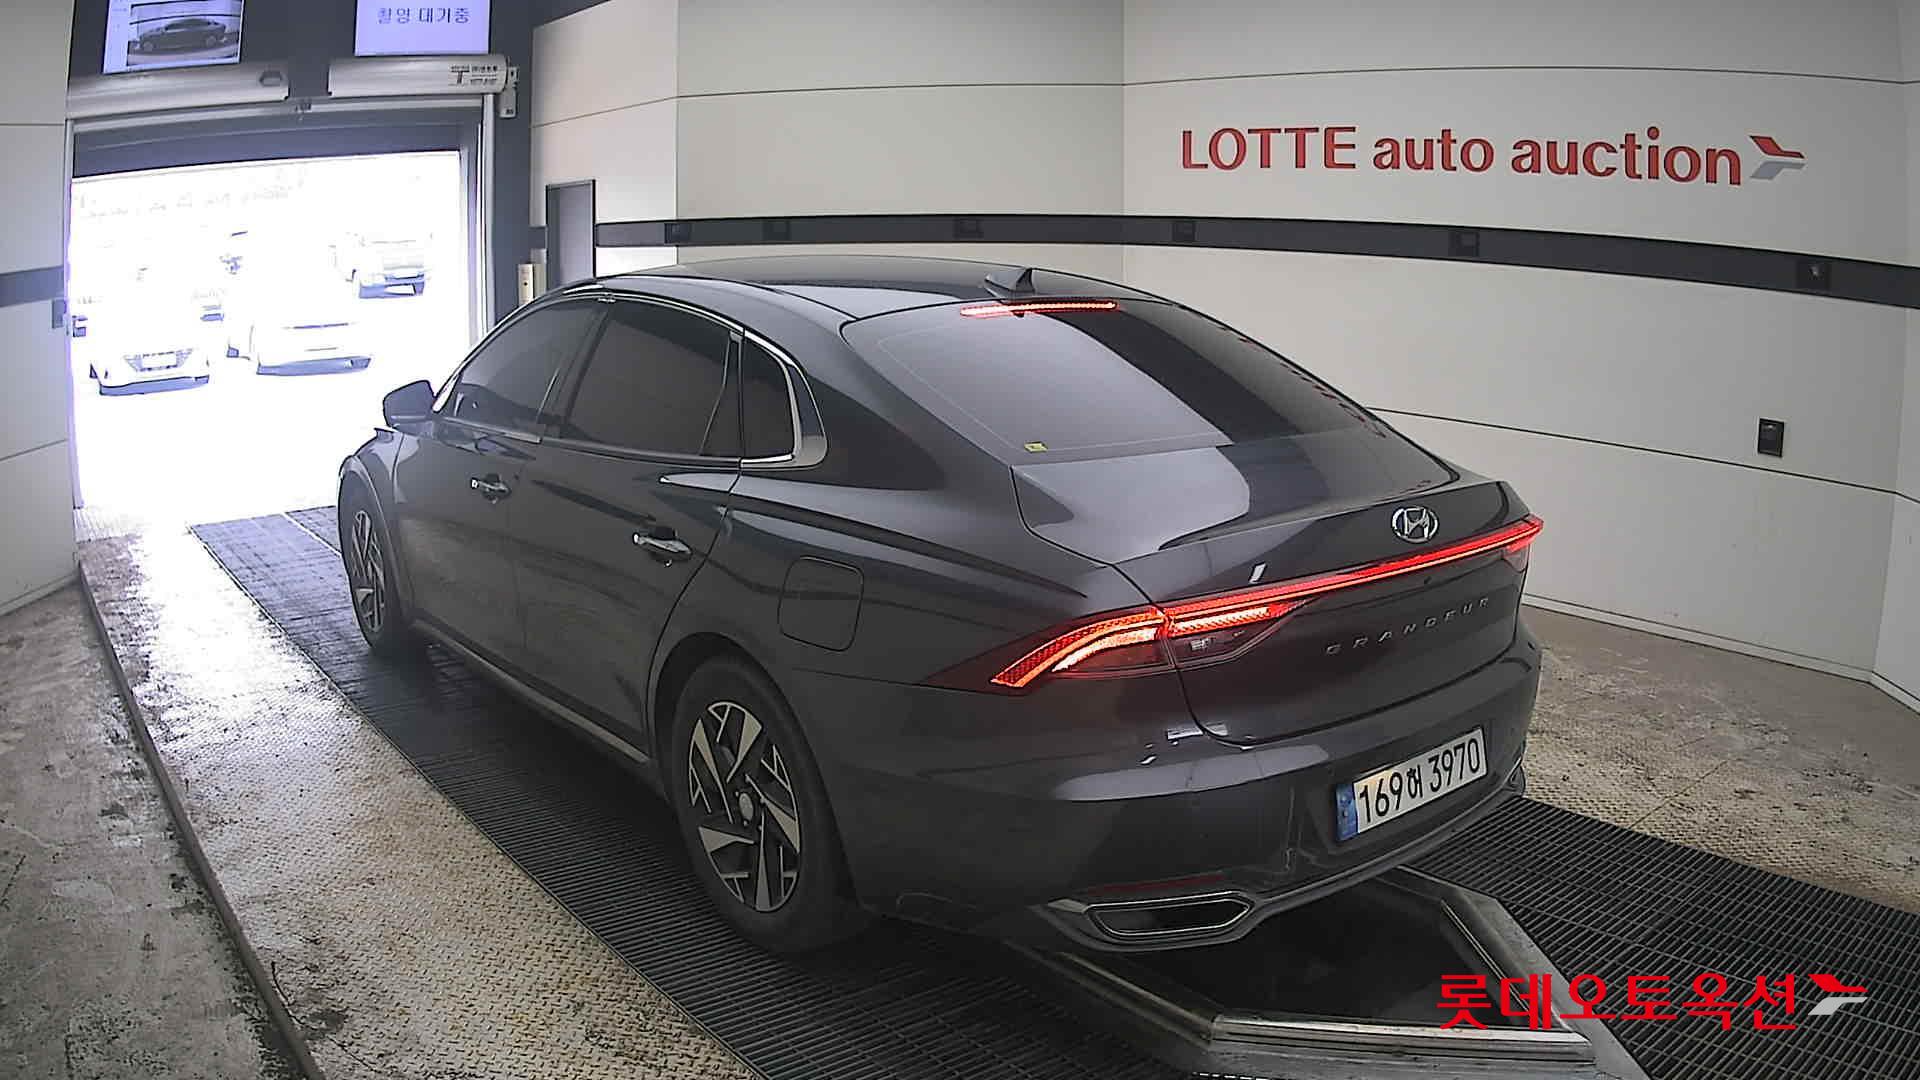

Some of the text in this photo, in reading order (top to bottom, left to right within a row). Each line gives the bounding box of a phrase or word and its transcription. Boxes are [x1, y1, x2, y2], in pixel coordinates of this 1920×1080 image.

[418, 7, 469, 24] 대기중
[1182, 126, 1742, 185] LOTTE auto auction
[1326, 597, 1490, 655] GRANDEUR
[1359, 738, 1481, 823] 169허 3970
